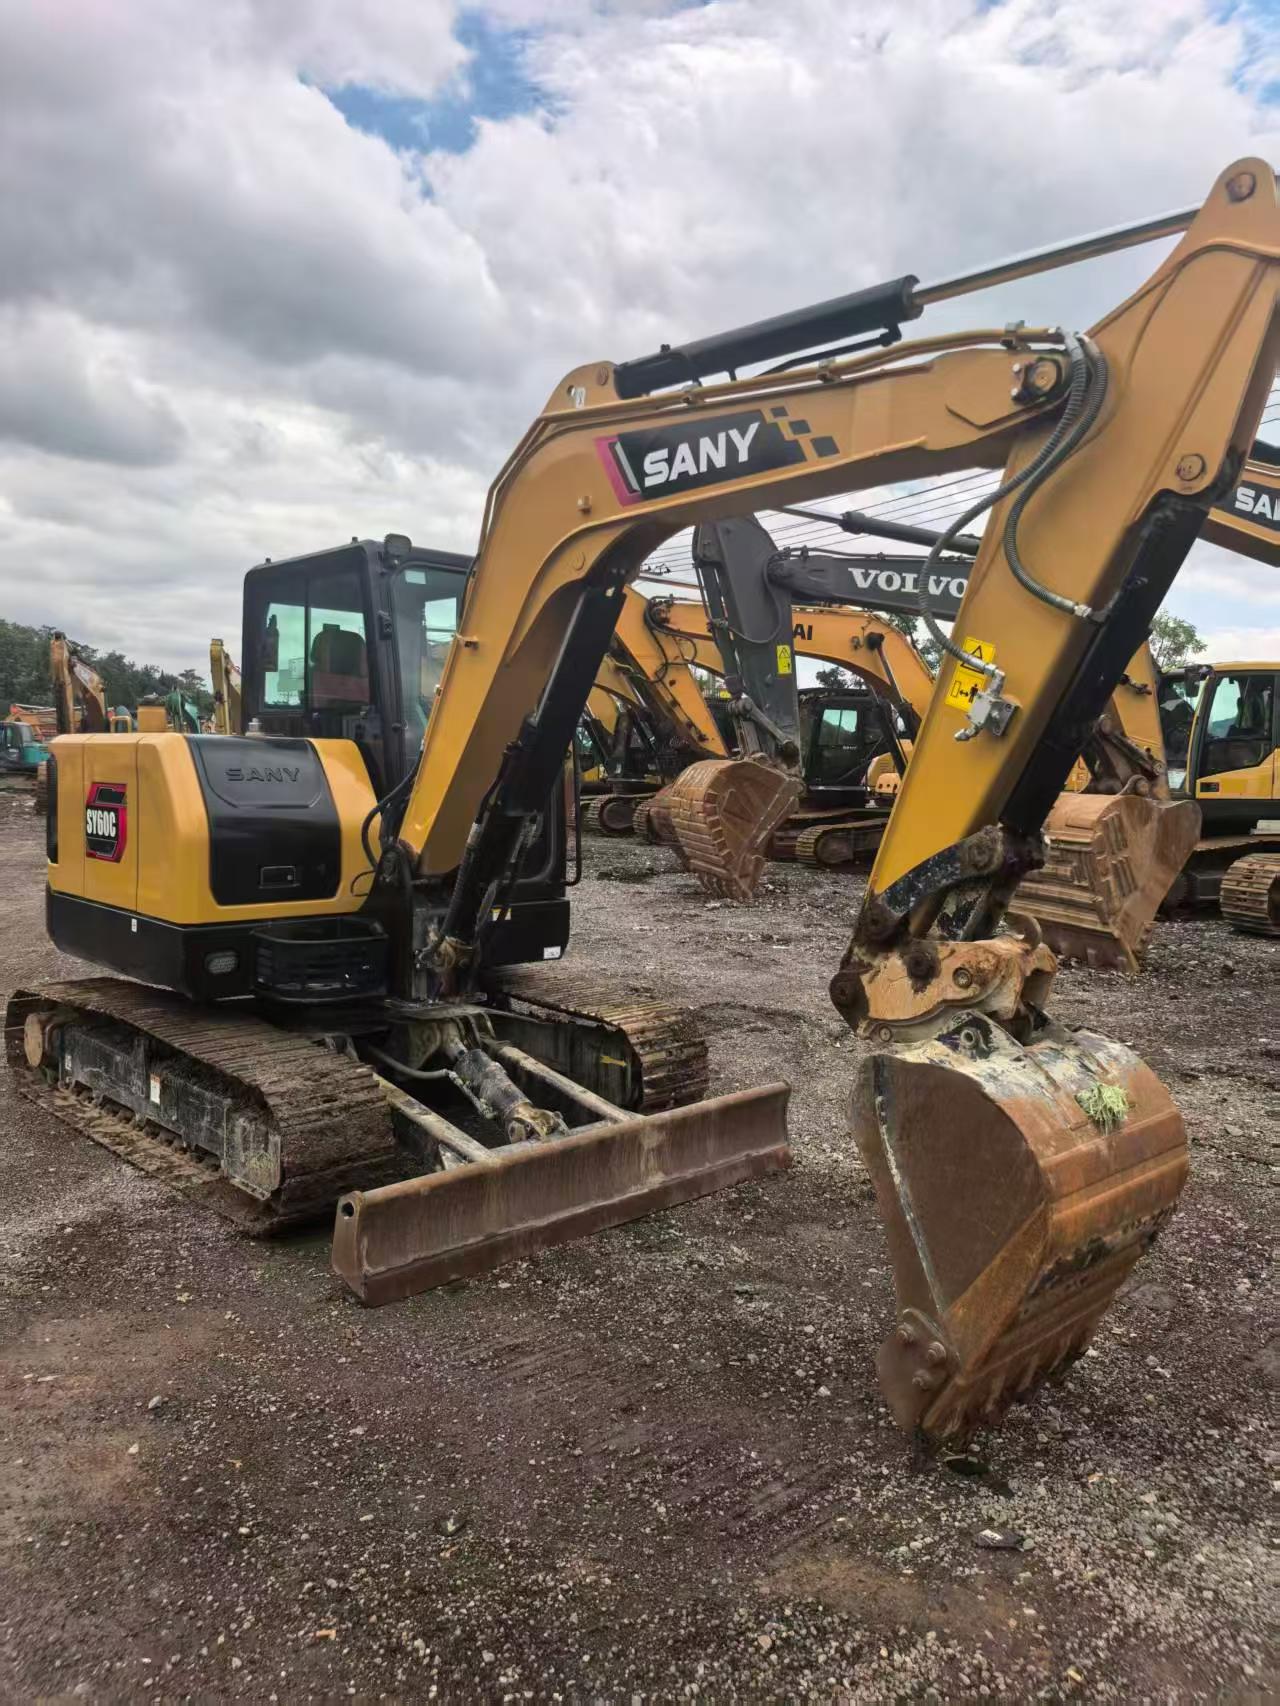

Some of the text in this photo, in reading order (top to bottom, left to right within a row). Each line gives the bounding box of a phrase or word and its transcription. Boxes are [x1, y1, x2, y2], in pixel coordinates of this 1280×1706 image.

[643, 422, 760, 487] SANY
[848, 567, 969, 598] VOLVO
[225, 768, 300, 782] SANY
[86, 809, 116, 838] SY60C
